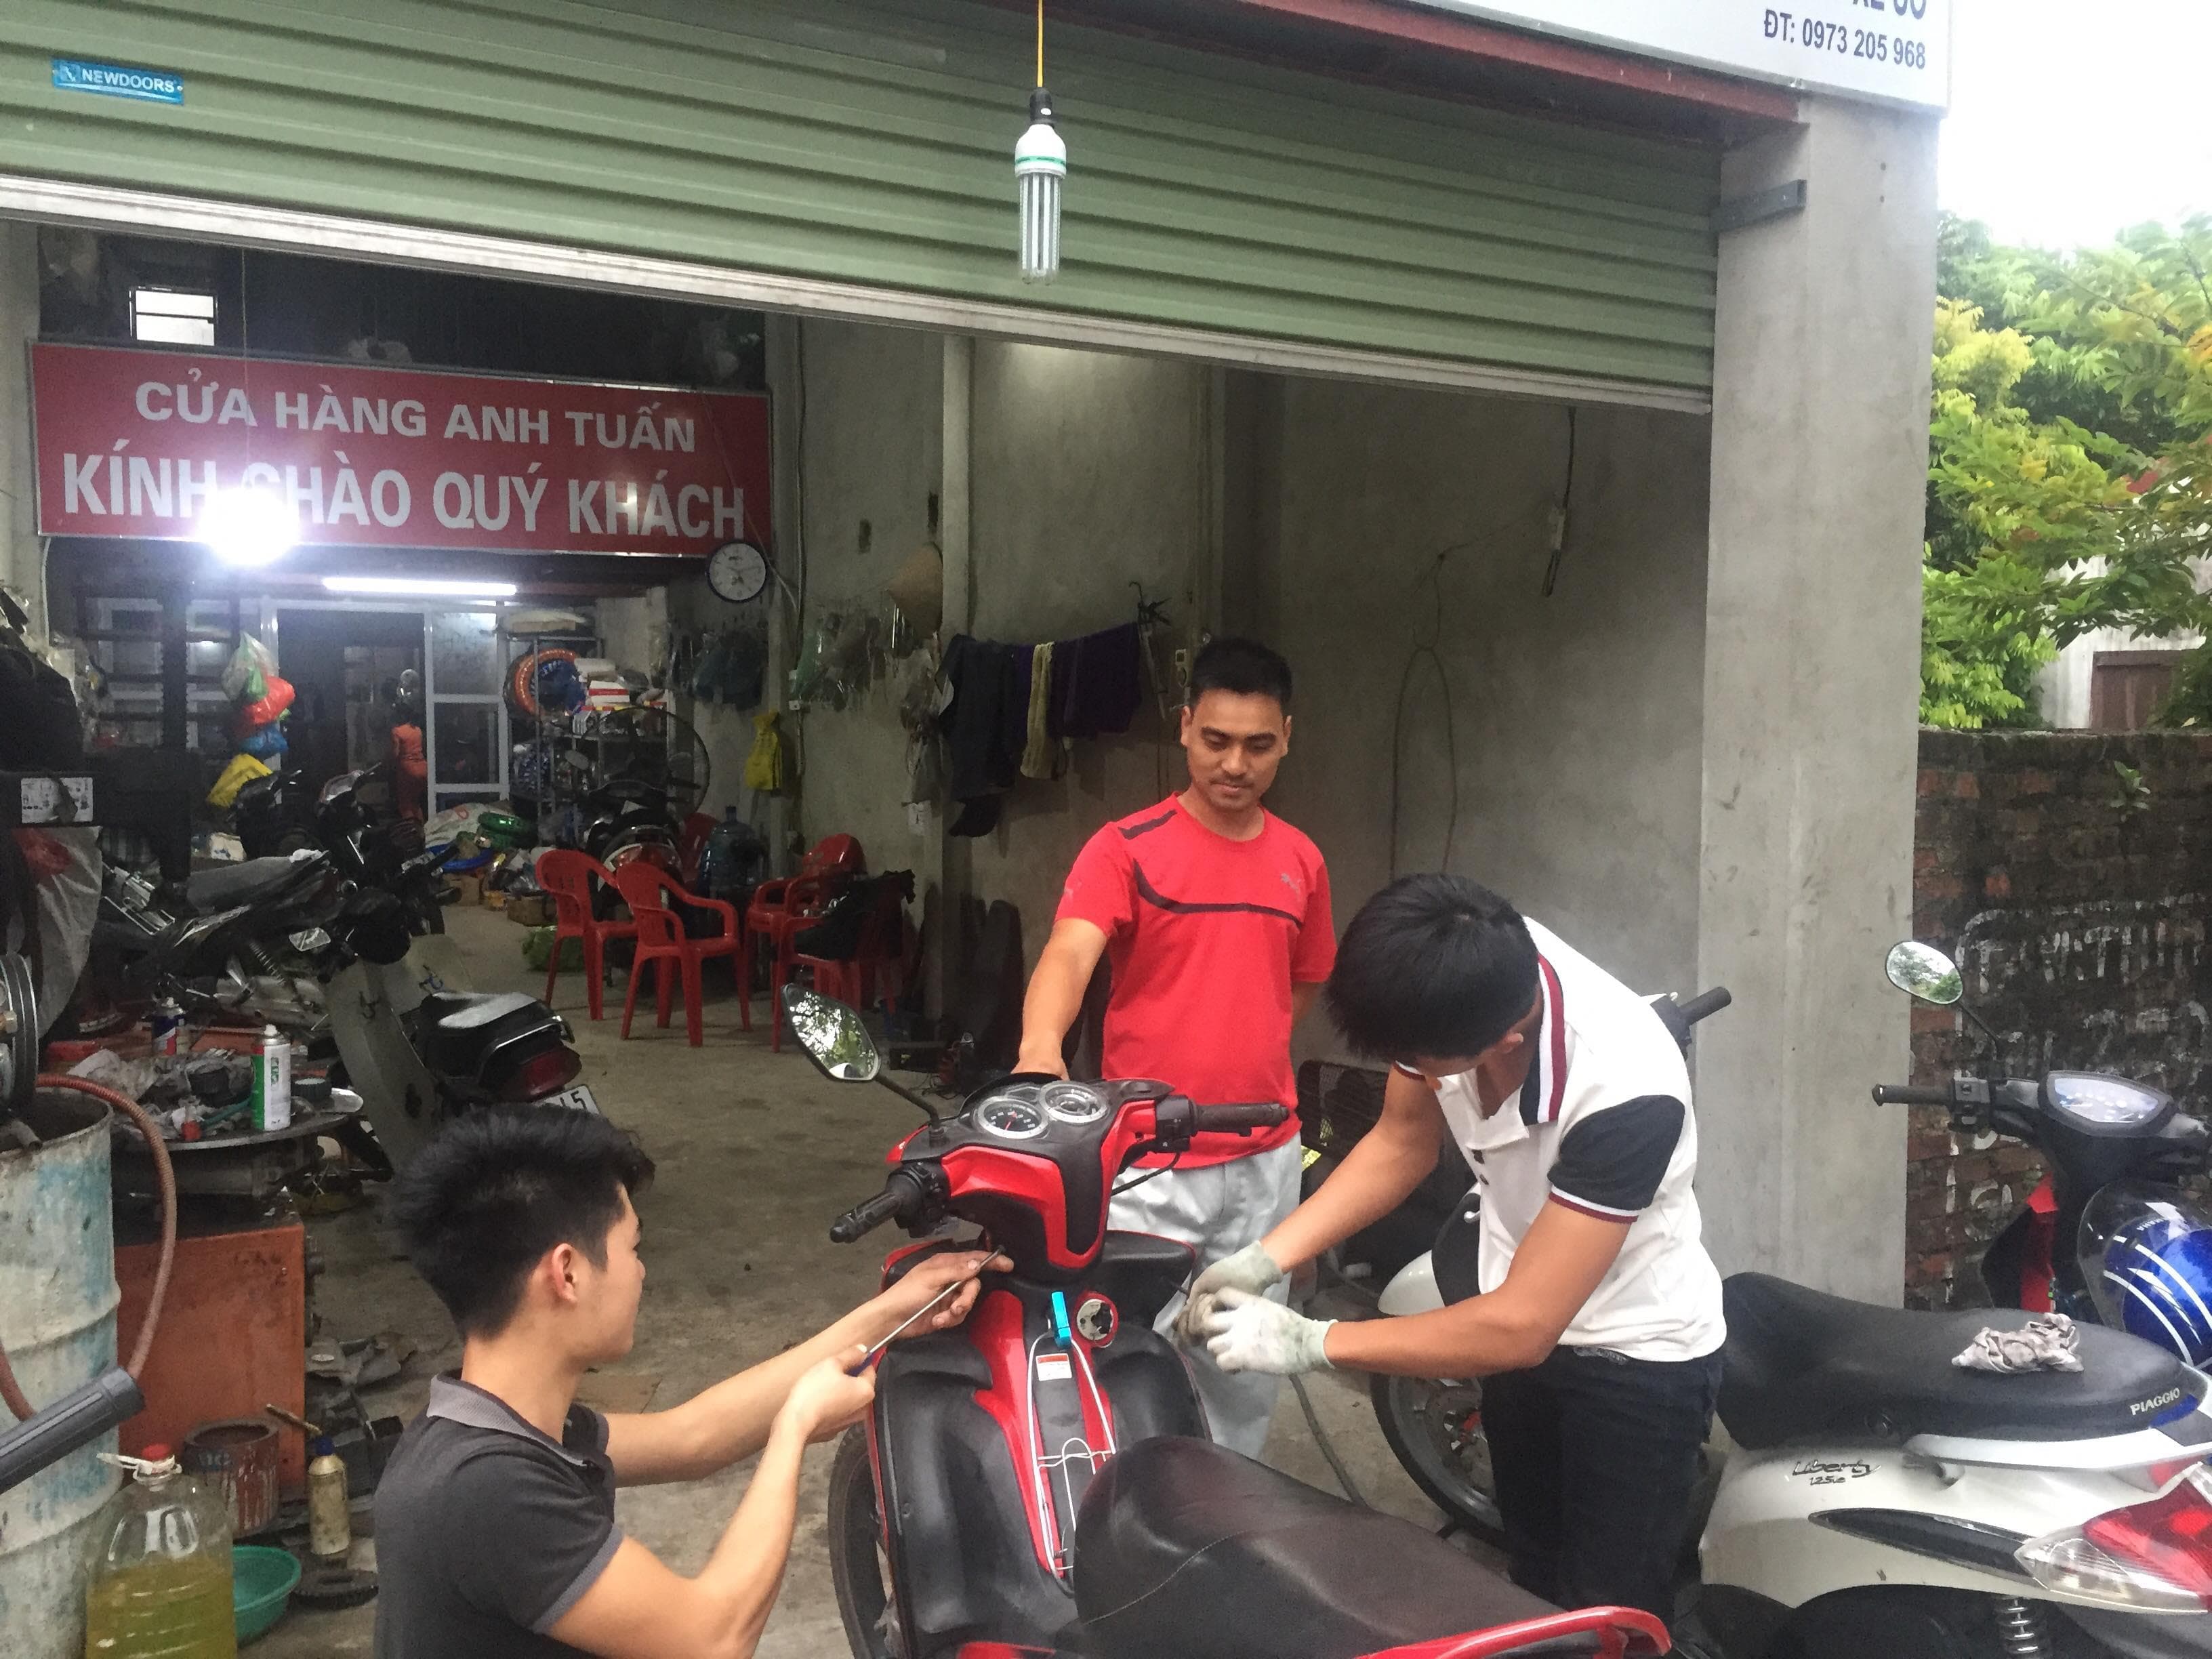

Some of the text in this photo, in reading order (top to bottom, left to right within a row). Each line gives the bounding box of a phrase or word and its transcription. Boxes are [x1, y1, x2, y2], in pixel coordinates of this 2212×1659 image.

[1764, 9, 1925, 69] ĐT: 0973 205 968
[81, 68, 175, 94] NEWDOORS
[136, 367, 695, 453] CỬA HÀNG ANH TUẤN
[63, 438, 218, 518] KÍNH
[432, 462, 548, 533] QUÝ
[567, 469, 745, 539] KHÁCH
[2129, 1387, 2181, 1416] PIAGGIO
